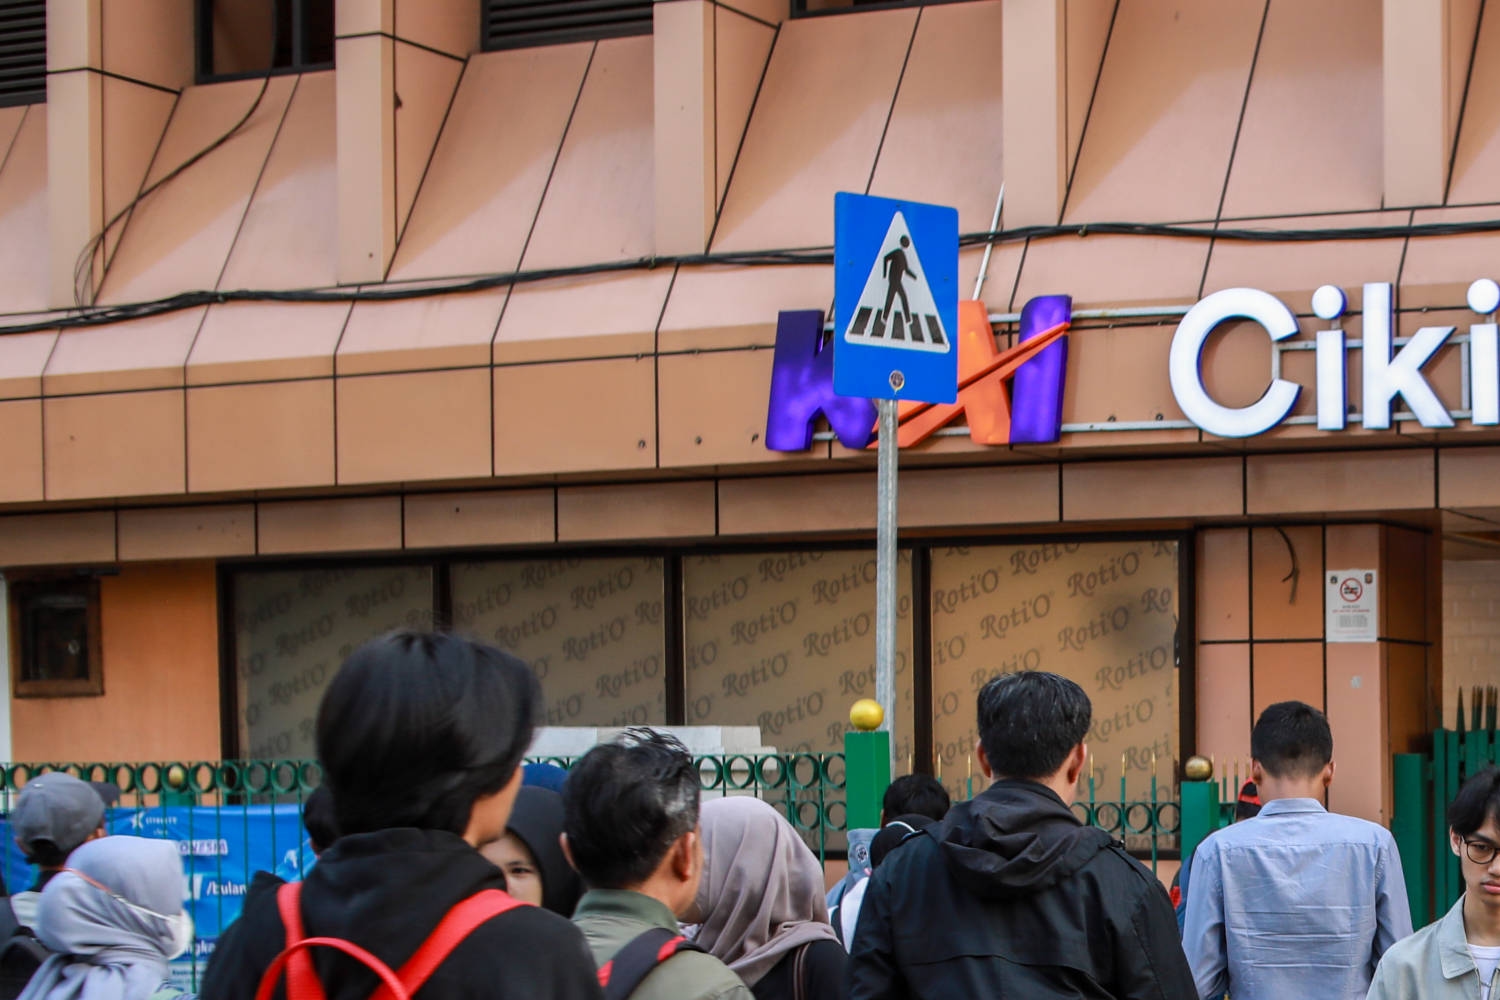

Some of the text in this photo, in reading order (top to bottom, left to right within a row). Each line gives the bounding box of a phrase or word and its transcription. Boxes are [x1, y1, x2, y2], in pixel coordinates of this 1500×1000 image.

[1067, 552, 1140, 597] Roti'O
[563, 616, 626, 662] Roti'O
[731, 601, 797, 645] Roti'O
[804, 612, 871, 657] Roti'O
[980, 594, 1051, 640] Roti'O
[1057, 606, 1130, 652] Roti'O
[596, 654, 659, 699] Roti'O
[722, 652, 789, 697] Roti'O
[757, 691, 824, 735] Roti'O
